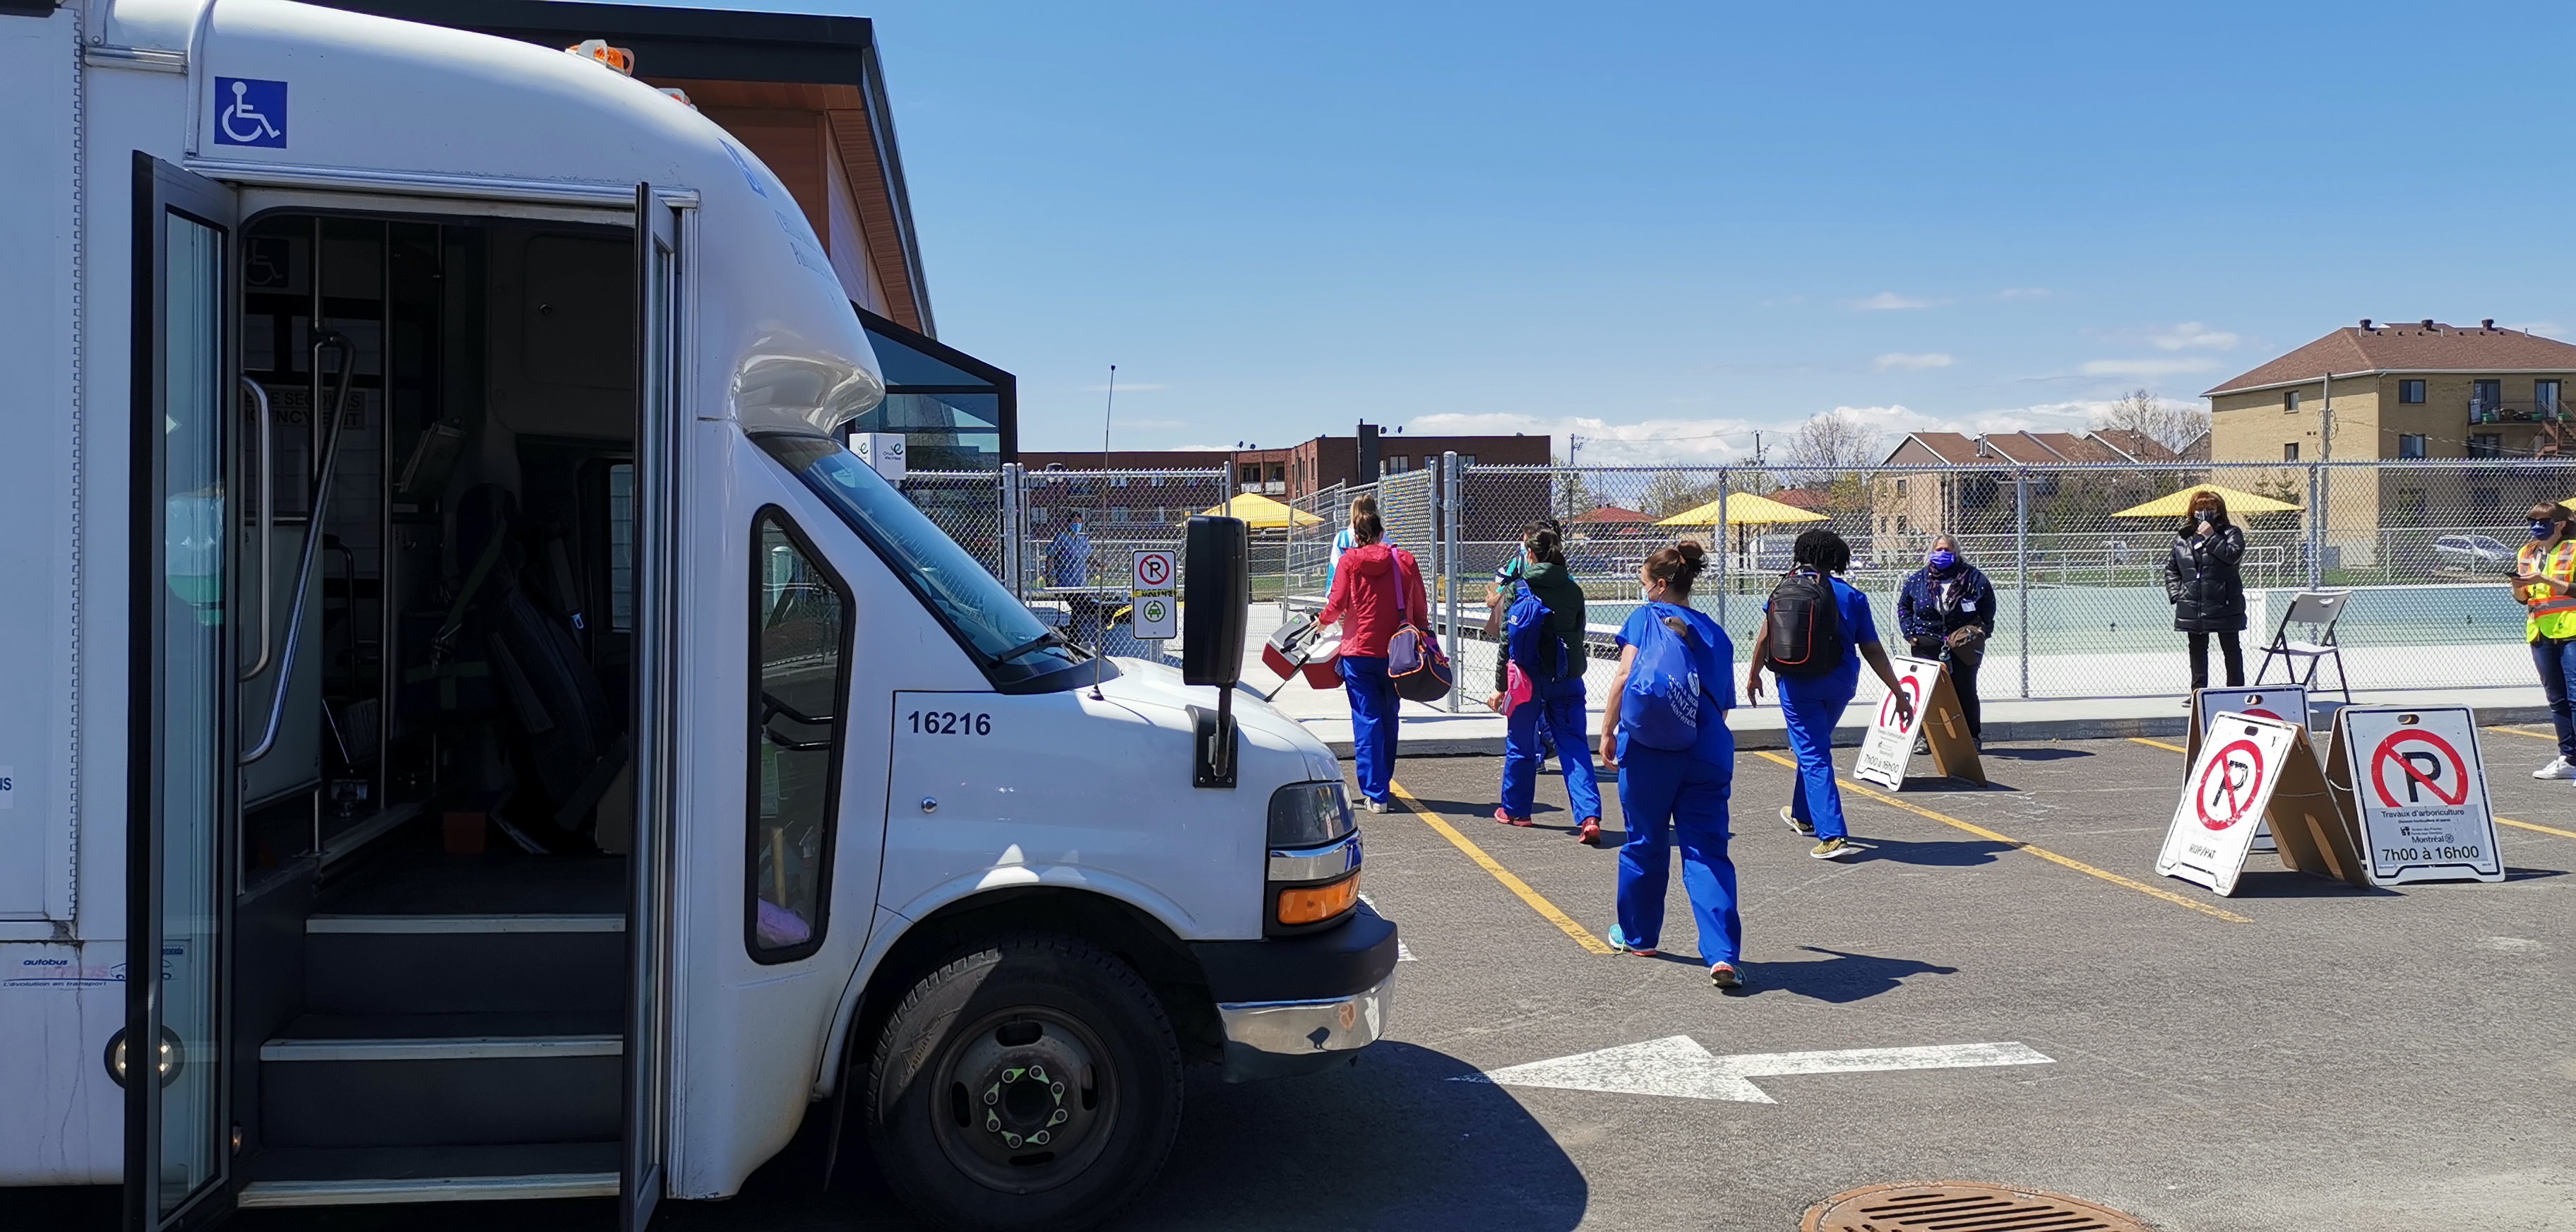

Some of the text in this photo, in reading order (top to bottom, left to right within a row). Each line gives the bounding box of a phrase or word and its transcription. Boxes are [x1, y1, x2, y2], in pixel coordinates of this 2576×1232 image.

[908, 711, 991, 735] 16216
[1864, 754, 1900, 773] 7h00 à 16h00
[2212, 760, 2248, 807] P
[2402, 752, 2441, 802] P
[2411, 835, 2445, 843] Montréal
[2188, 843, 2217, 859] RDP/PAT
[2382, 846, 2479, 861] 7h00 à 16h00
